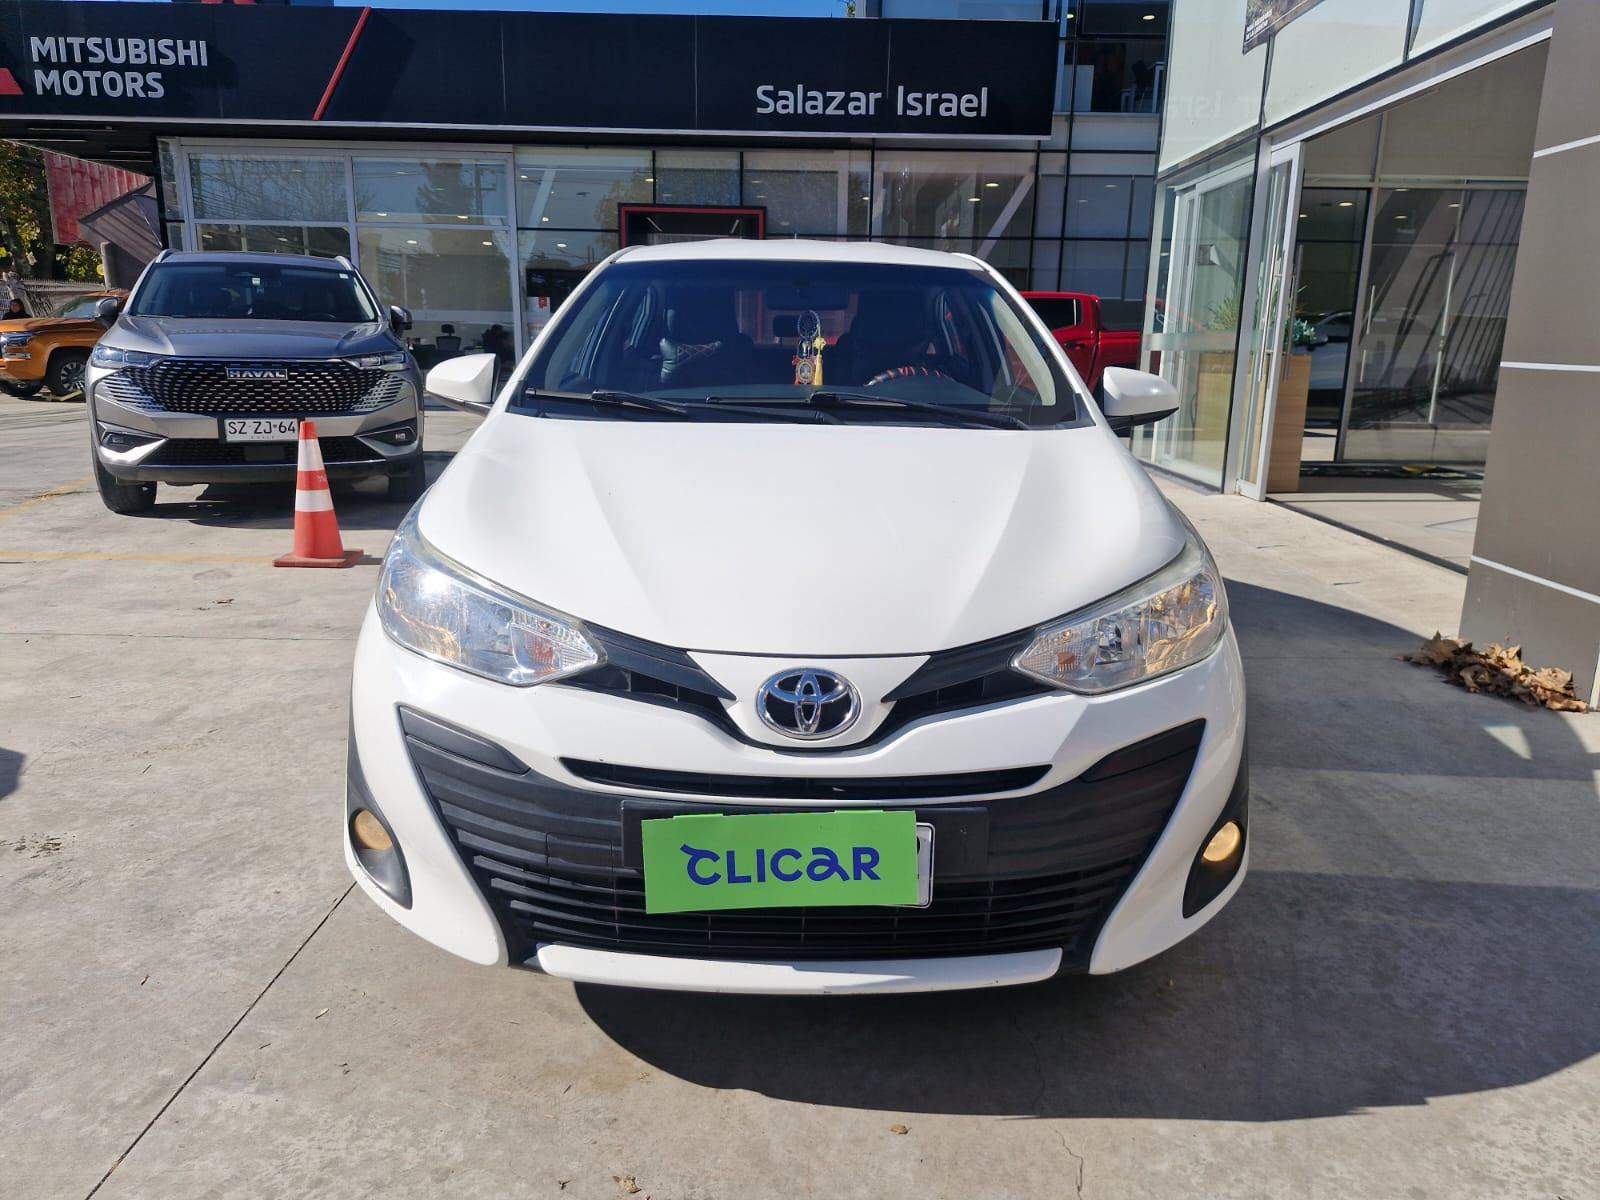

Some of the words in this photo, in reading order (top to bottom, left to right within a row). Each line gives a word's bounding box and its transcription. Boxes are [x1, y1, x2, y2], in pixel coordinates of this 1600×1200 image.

[30, 36, 208, 67] MITSUBISHI
[34, 69, 165, 99] MOTORS
[756, 84, 882, 115] Salazar
[897, 85, 988, 117] Israel
[229, 370, 286, 378] HAVAL
